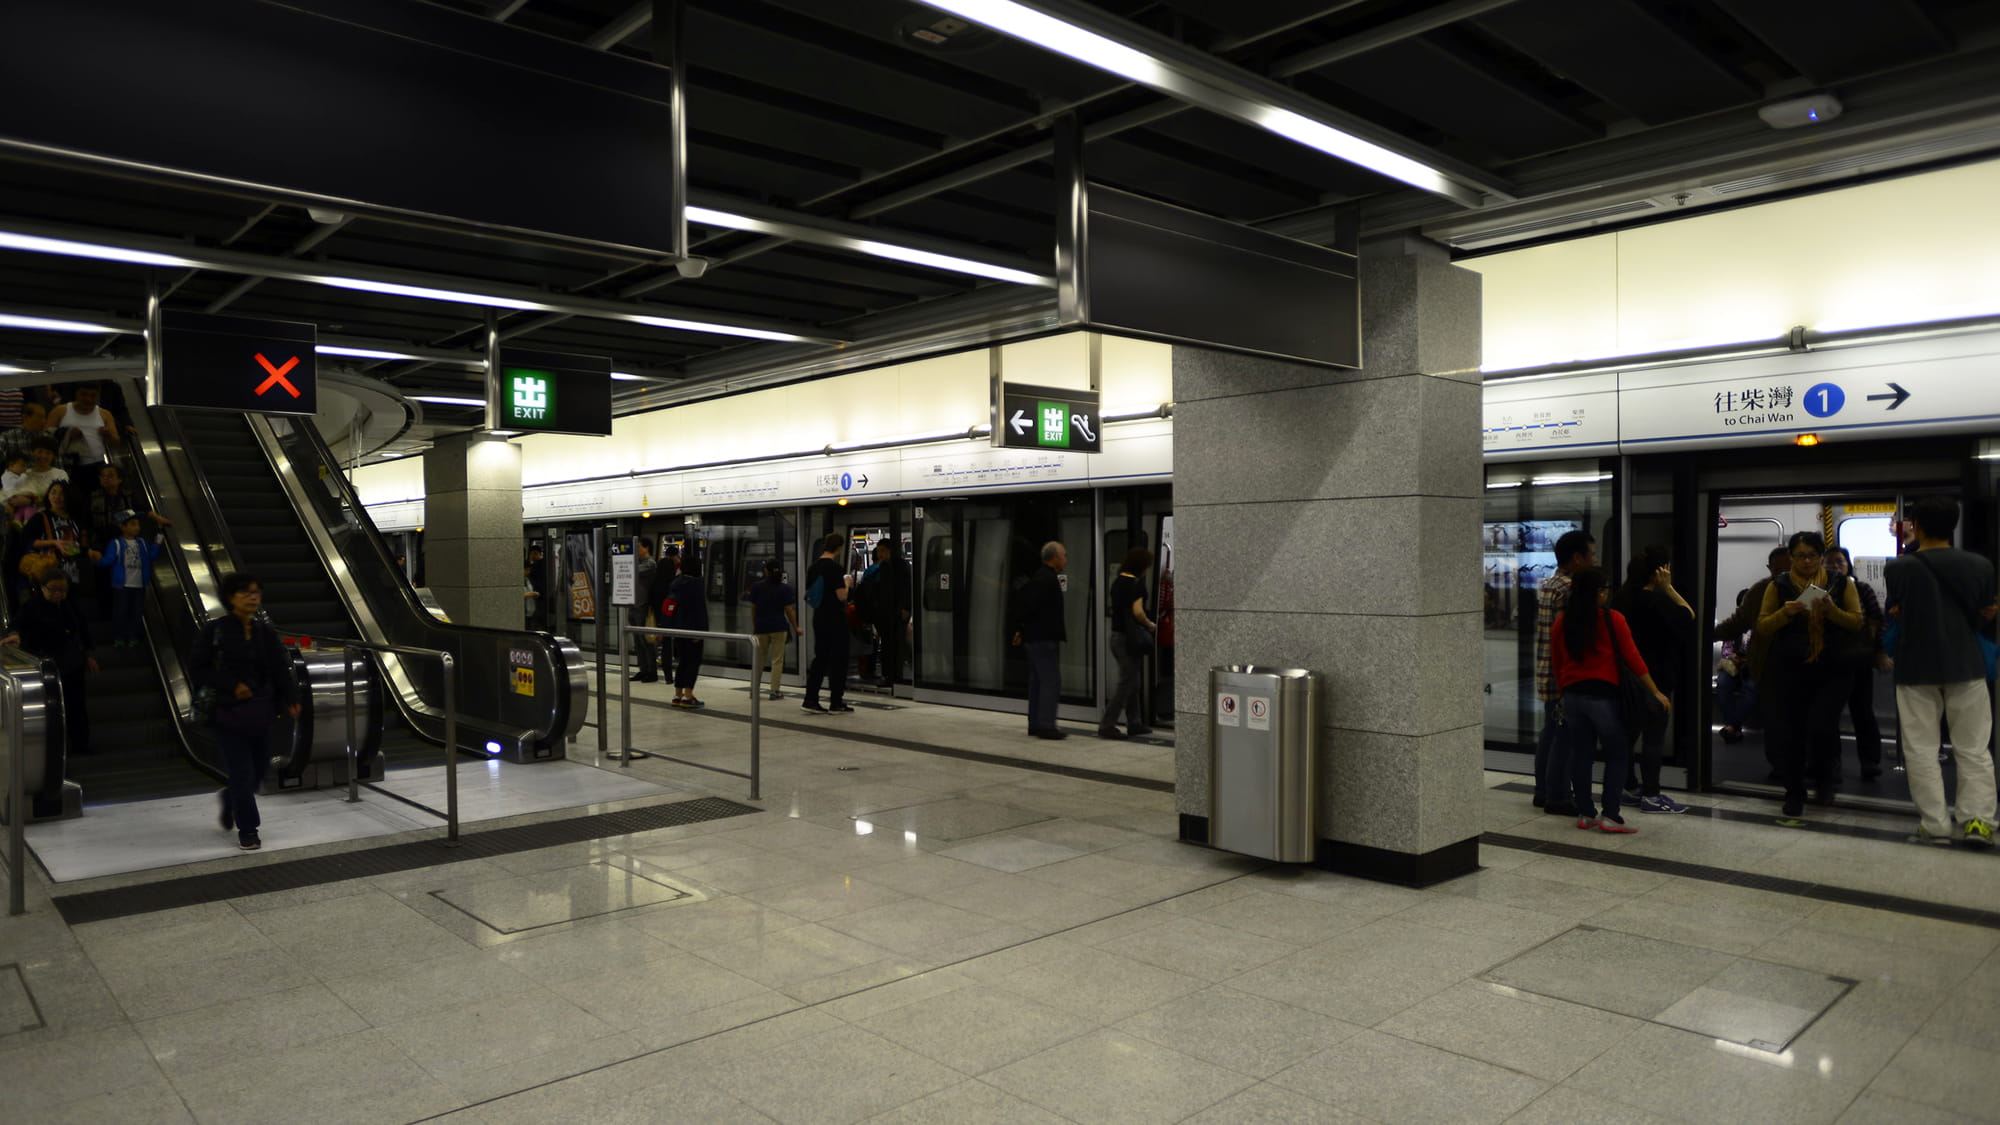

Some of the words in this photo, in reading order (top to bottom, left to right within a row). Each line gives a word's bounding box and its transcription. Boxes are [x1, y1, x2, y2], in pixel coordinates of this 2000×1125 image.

[1714, 385, 1794, 413] 往柴灣
[513, 406, 546, 420] EXIT
[1724, 416, 1737, 426] to
[1739, 413, 1765, 425] Chai
[1767, 412, 1794, 424] Wan
[1044, 430, 1063, 441] EXIT
